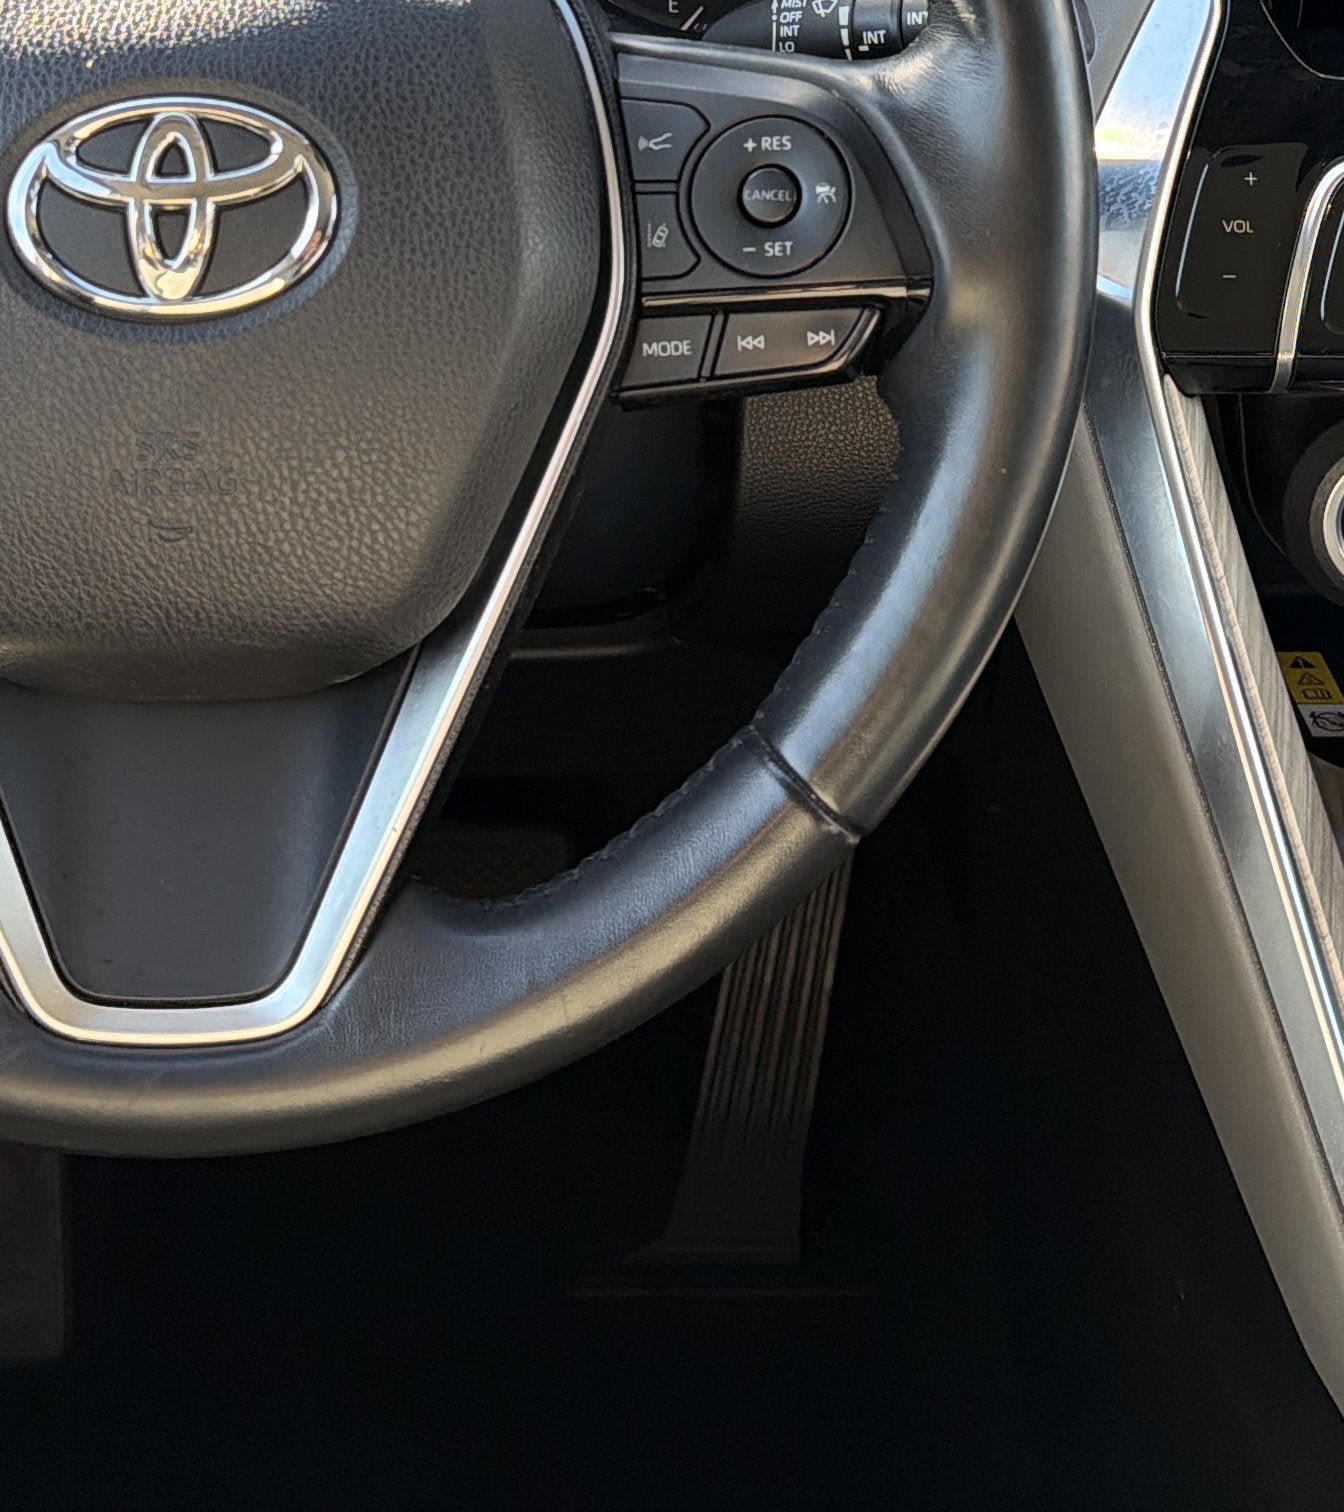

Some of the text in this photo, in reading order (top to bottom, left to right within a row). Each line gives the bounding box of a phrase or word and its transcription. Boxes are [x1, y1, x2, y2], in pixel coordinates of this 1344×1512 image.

[780, 11, 803, 23] OFF
[780, 25, 800, 38] INT
[863, 30, 886, 45] INT
[779, 41, 795, 53] LO
[761, 136, 792, 151] RES
[745, 189, 793, 201] CANCEL
[1222, 219, 1255, 234] VOL
[764, 241, 793, 256] SET
[642, 339, 692, 356] MODE
[110, 467, 239, 497] AIRBAG
